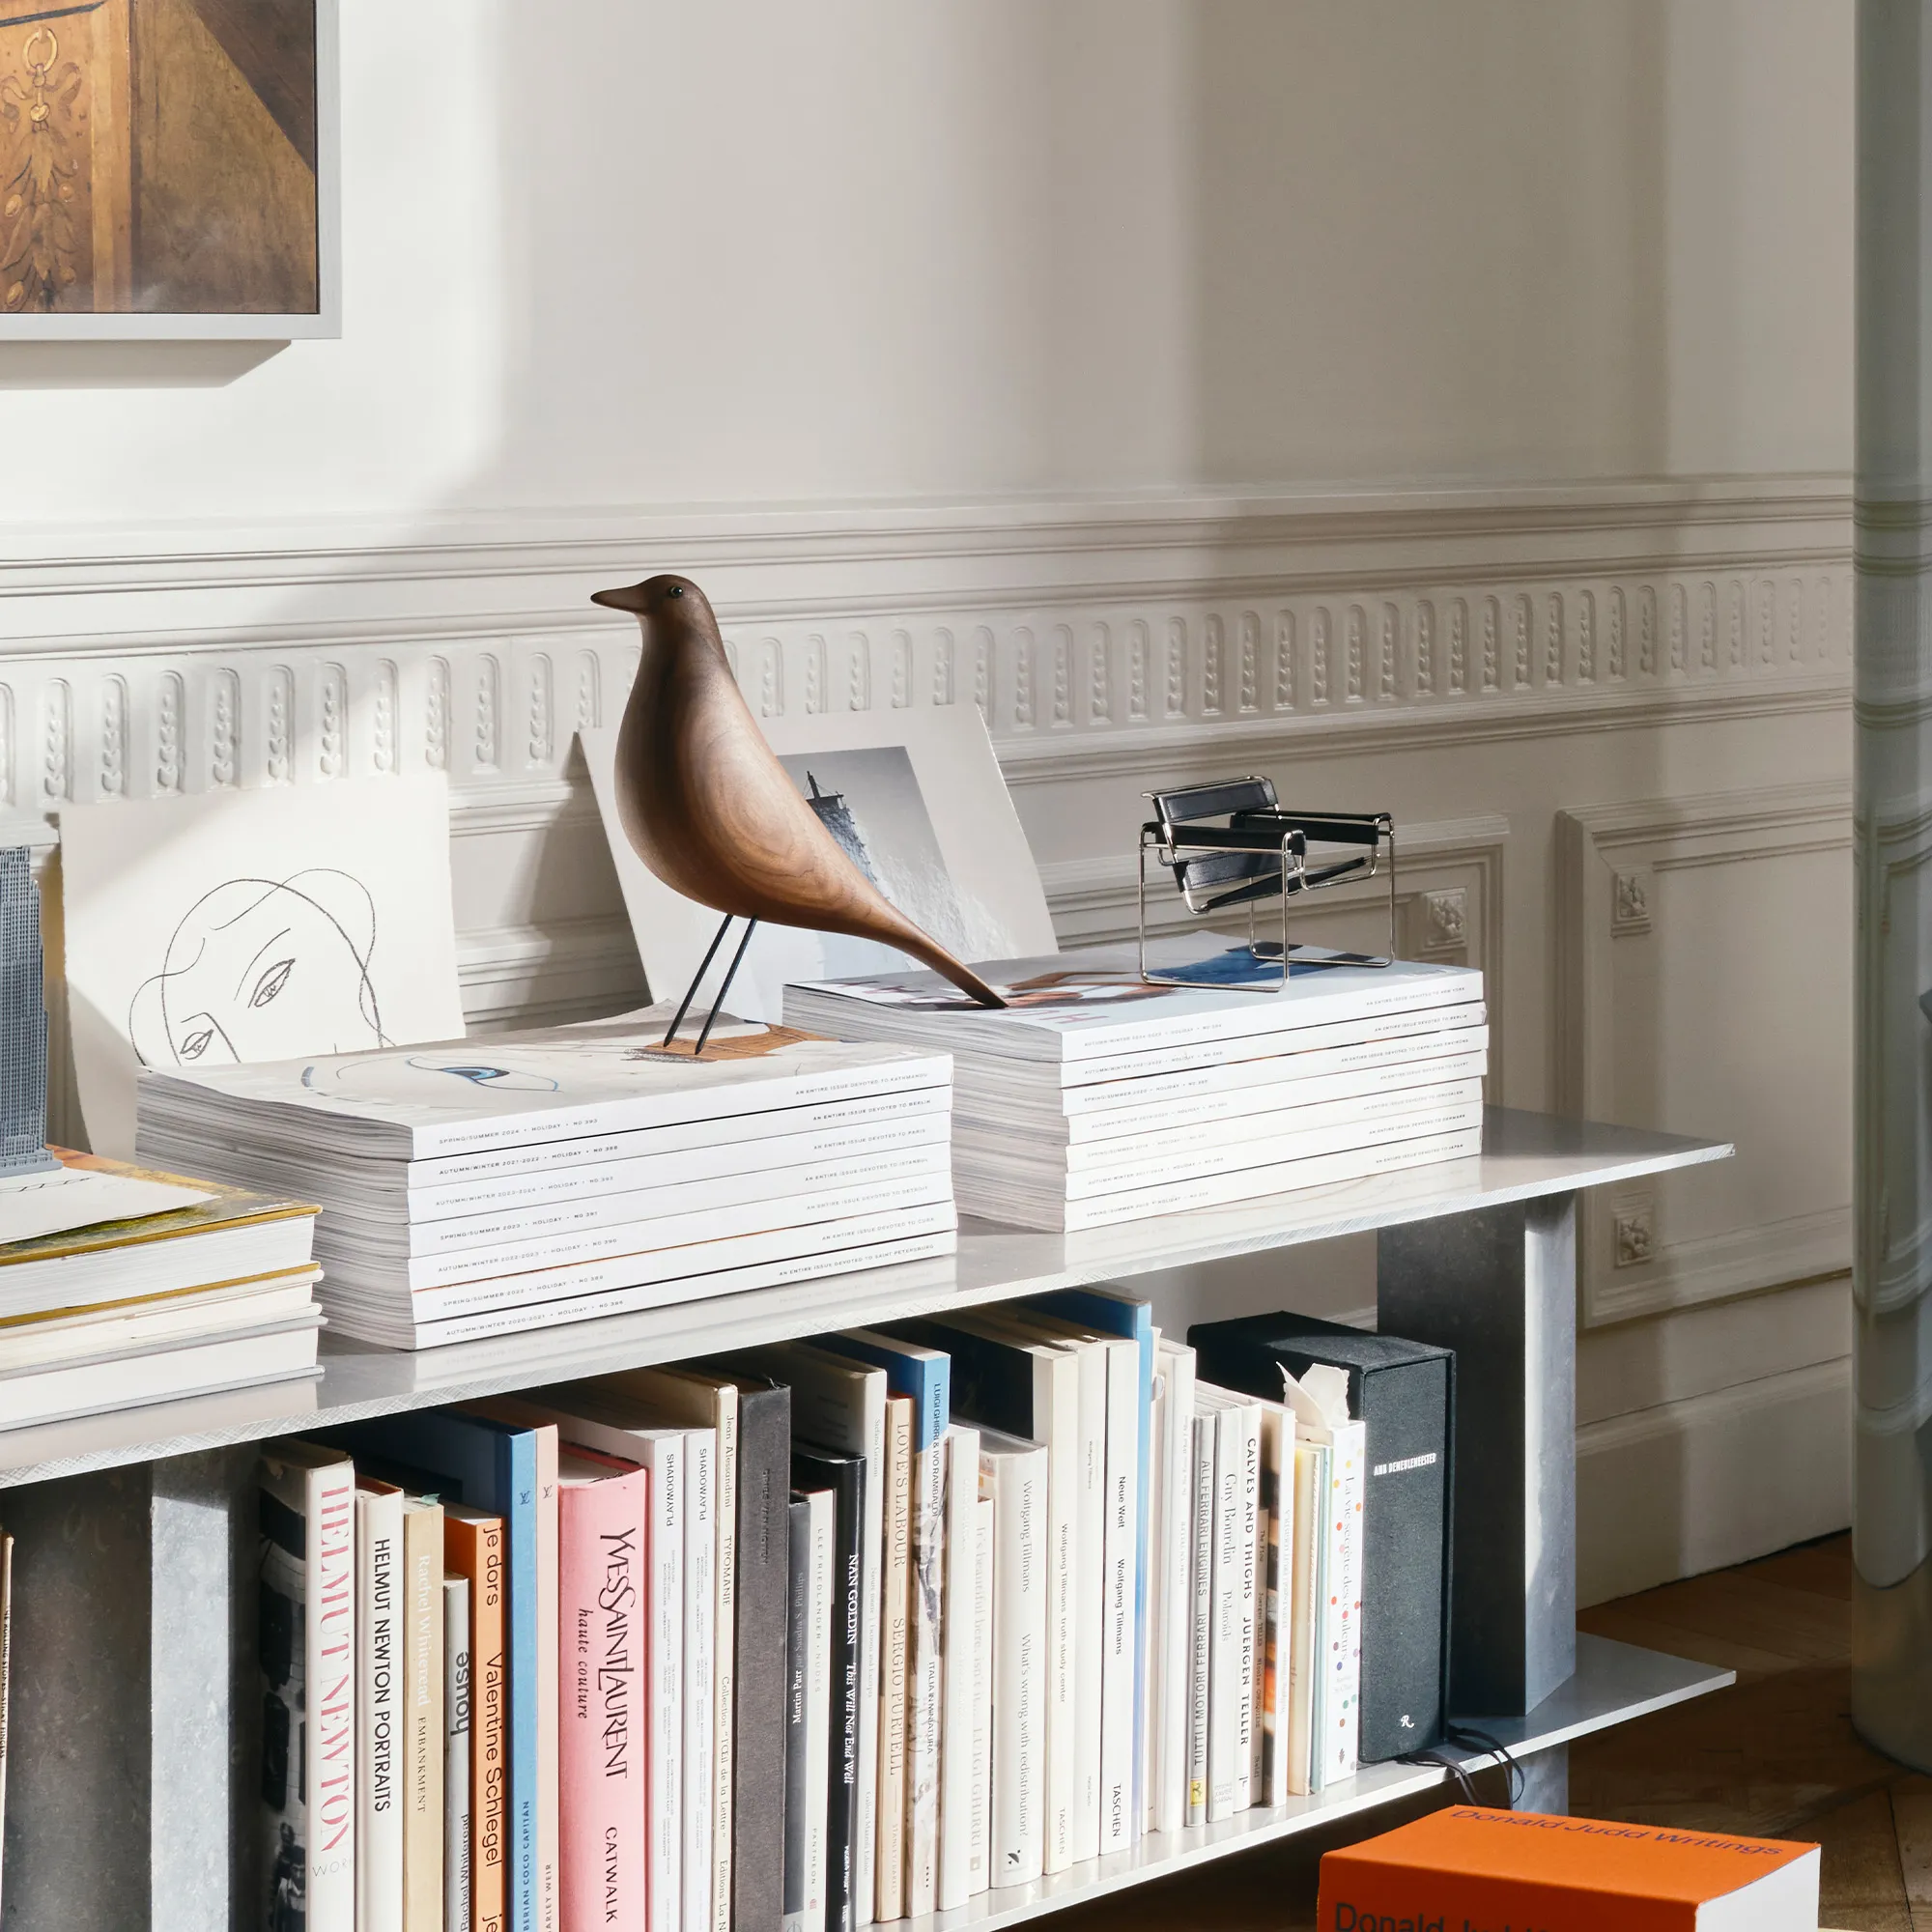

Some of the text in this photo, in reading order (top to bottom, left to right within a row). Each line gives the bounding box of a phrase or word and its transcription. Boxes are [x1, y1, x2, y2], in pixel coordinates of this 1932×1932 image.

[440, 1131, 499, 1144] SPRING/SUMMER
[531, 1123, 561, 1132] HOLIDAY
[439, 1162, 500, 1175] AUTUMN/WINTER
[502, 1156, 540, 1166] 2021-2022
[552, 1151, 582, 1159] HOLIDAY
[440, 1226, 500, 1240] SPRING/SUMMER
[532, 1216, 562, 1226] HOLIDAY
[446, 1321, 506, 1336] AUTUMN/WINTER
[508, 1314, 546, 1325] 2020-2021
[557, 1307, 587, 1317] HOLIDAY
[724, 1414, 734, 1441] Jean
[724, 1445, 734, 1508] Alessandrini
[1246, 1437, 1256, 1493] CALVES
[483, 1527, 502, 1548] je
[895, 1494, 908, 1568] LABOUR
[1020, 1480, 1033, 1540] Wolfgang
[1198, 1461, 1210, 1596] ALL FERRARI ENGINES
[723, 1535, 732, 1606] TYPOMANIE
[1022, 1542, 1033, 1592] Tillmans
[1060, 1522, 1068, 1570] Wolfgang
[1221, 1474, 1236, 1642] Guy Bourdin Polaroids
[1244, 1542, 1254, 1600] THIGHS
[1341, 1476, 1355, 1661] La vie secrète des culeurs
[485, 1553, 502, 1606] dors
[1060, 1573, 1068, 1612] Tillmans
[578, 1608, 593, 1719] haute couture
[891, 1618, 905, 1687] SERGIO
[1112, 1476, 1126, 1837] Neue Welt Wolfgang Tillmans TASCHEN
[1196, 1613, 1208, 1665] FERRARI
[1242, 1617, 1252, 1686] JUERGEN
[320, 1486, 350, 1852] HELMUT NEWTON
[374, 1538, 390, 1812] HELMUT NEWTON PORTRAITS
[415, 1554, 431, 1812] Rachel Whiteread EMBANKMENT
[449, 1652, 469, 1737] house
[792, 1669, 803, 1723] Martin Parr
[843, 1553, 859, 1783] NAN GOLDIN This Will Not End Well
[1195, 1671, 1206, 1719] MOTORI
[485, 1651, 502, 1762] Valentine
[721, 1677, 729, 1727] Collection
[1018, 1679, 1028, 1719] wrong
[1240, 1694, 1250, 1746] TELLER
[890, 1692, 904, 1776] PURTELL
[1020, 1720, 1030, 1747] with
[1194, 1731, 1204, 1766] TUTTI
[720, 1785, 728, 1796] la
[721, 1768, 728, 1781] de
[971, 1728, 982, 1847] LUIGI GHIRRI
[1019, 1751, 1030, 1836] redistribution?
[481, 1768, 502, 1868] Schlegel
[1451, 1810, 1783, 1855] Donald Judd Writings
[605, 1827, 618, 1922] CATWALK
[719, 1903, 727, 1917] La
